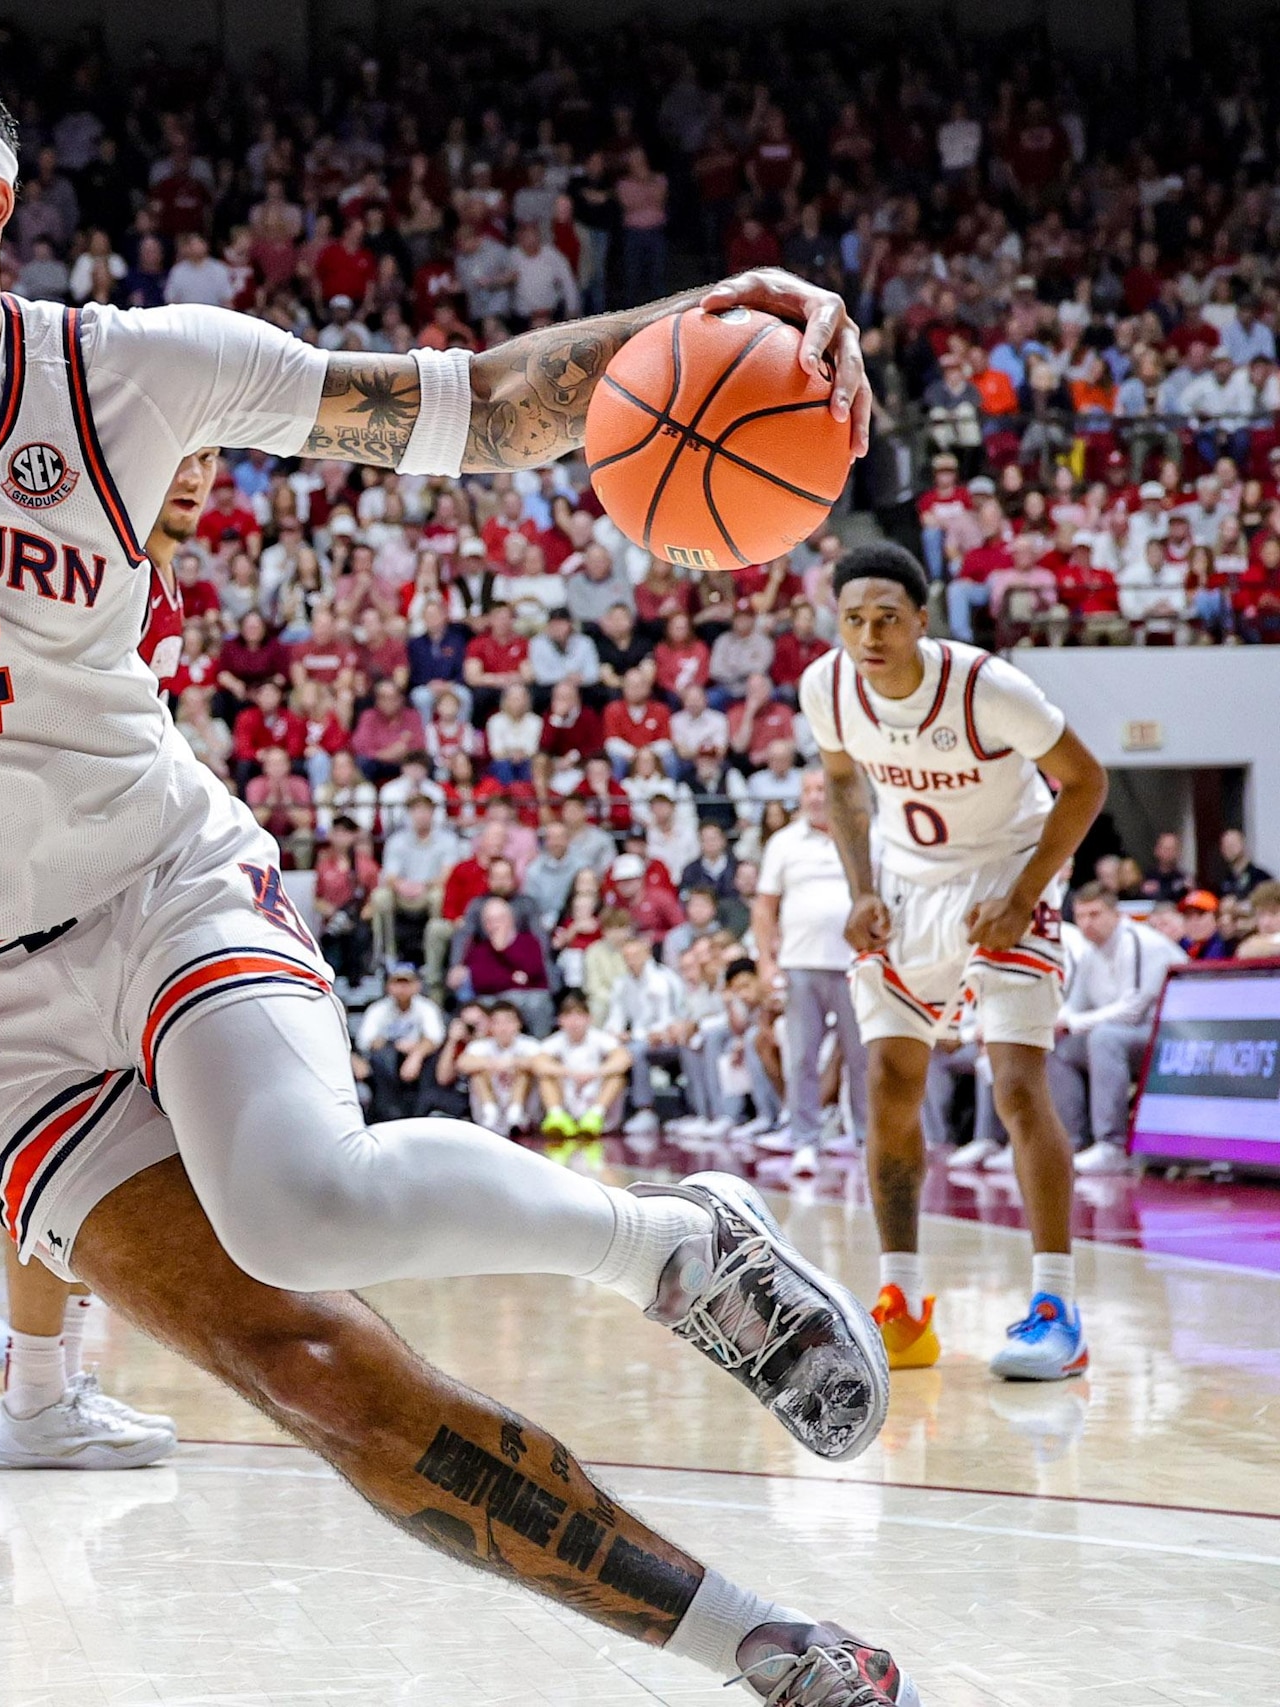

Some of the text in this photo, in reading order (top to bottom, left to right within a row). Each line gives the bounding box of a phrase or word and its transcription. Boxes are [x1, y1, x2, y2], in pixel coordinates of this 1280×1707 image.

[13, 445, 62, 492] SEC
[12, 483, 71, 508] GRADUATE
[902, 801, 949, 847] 0
